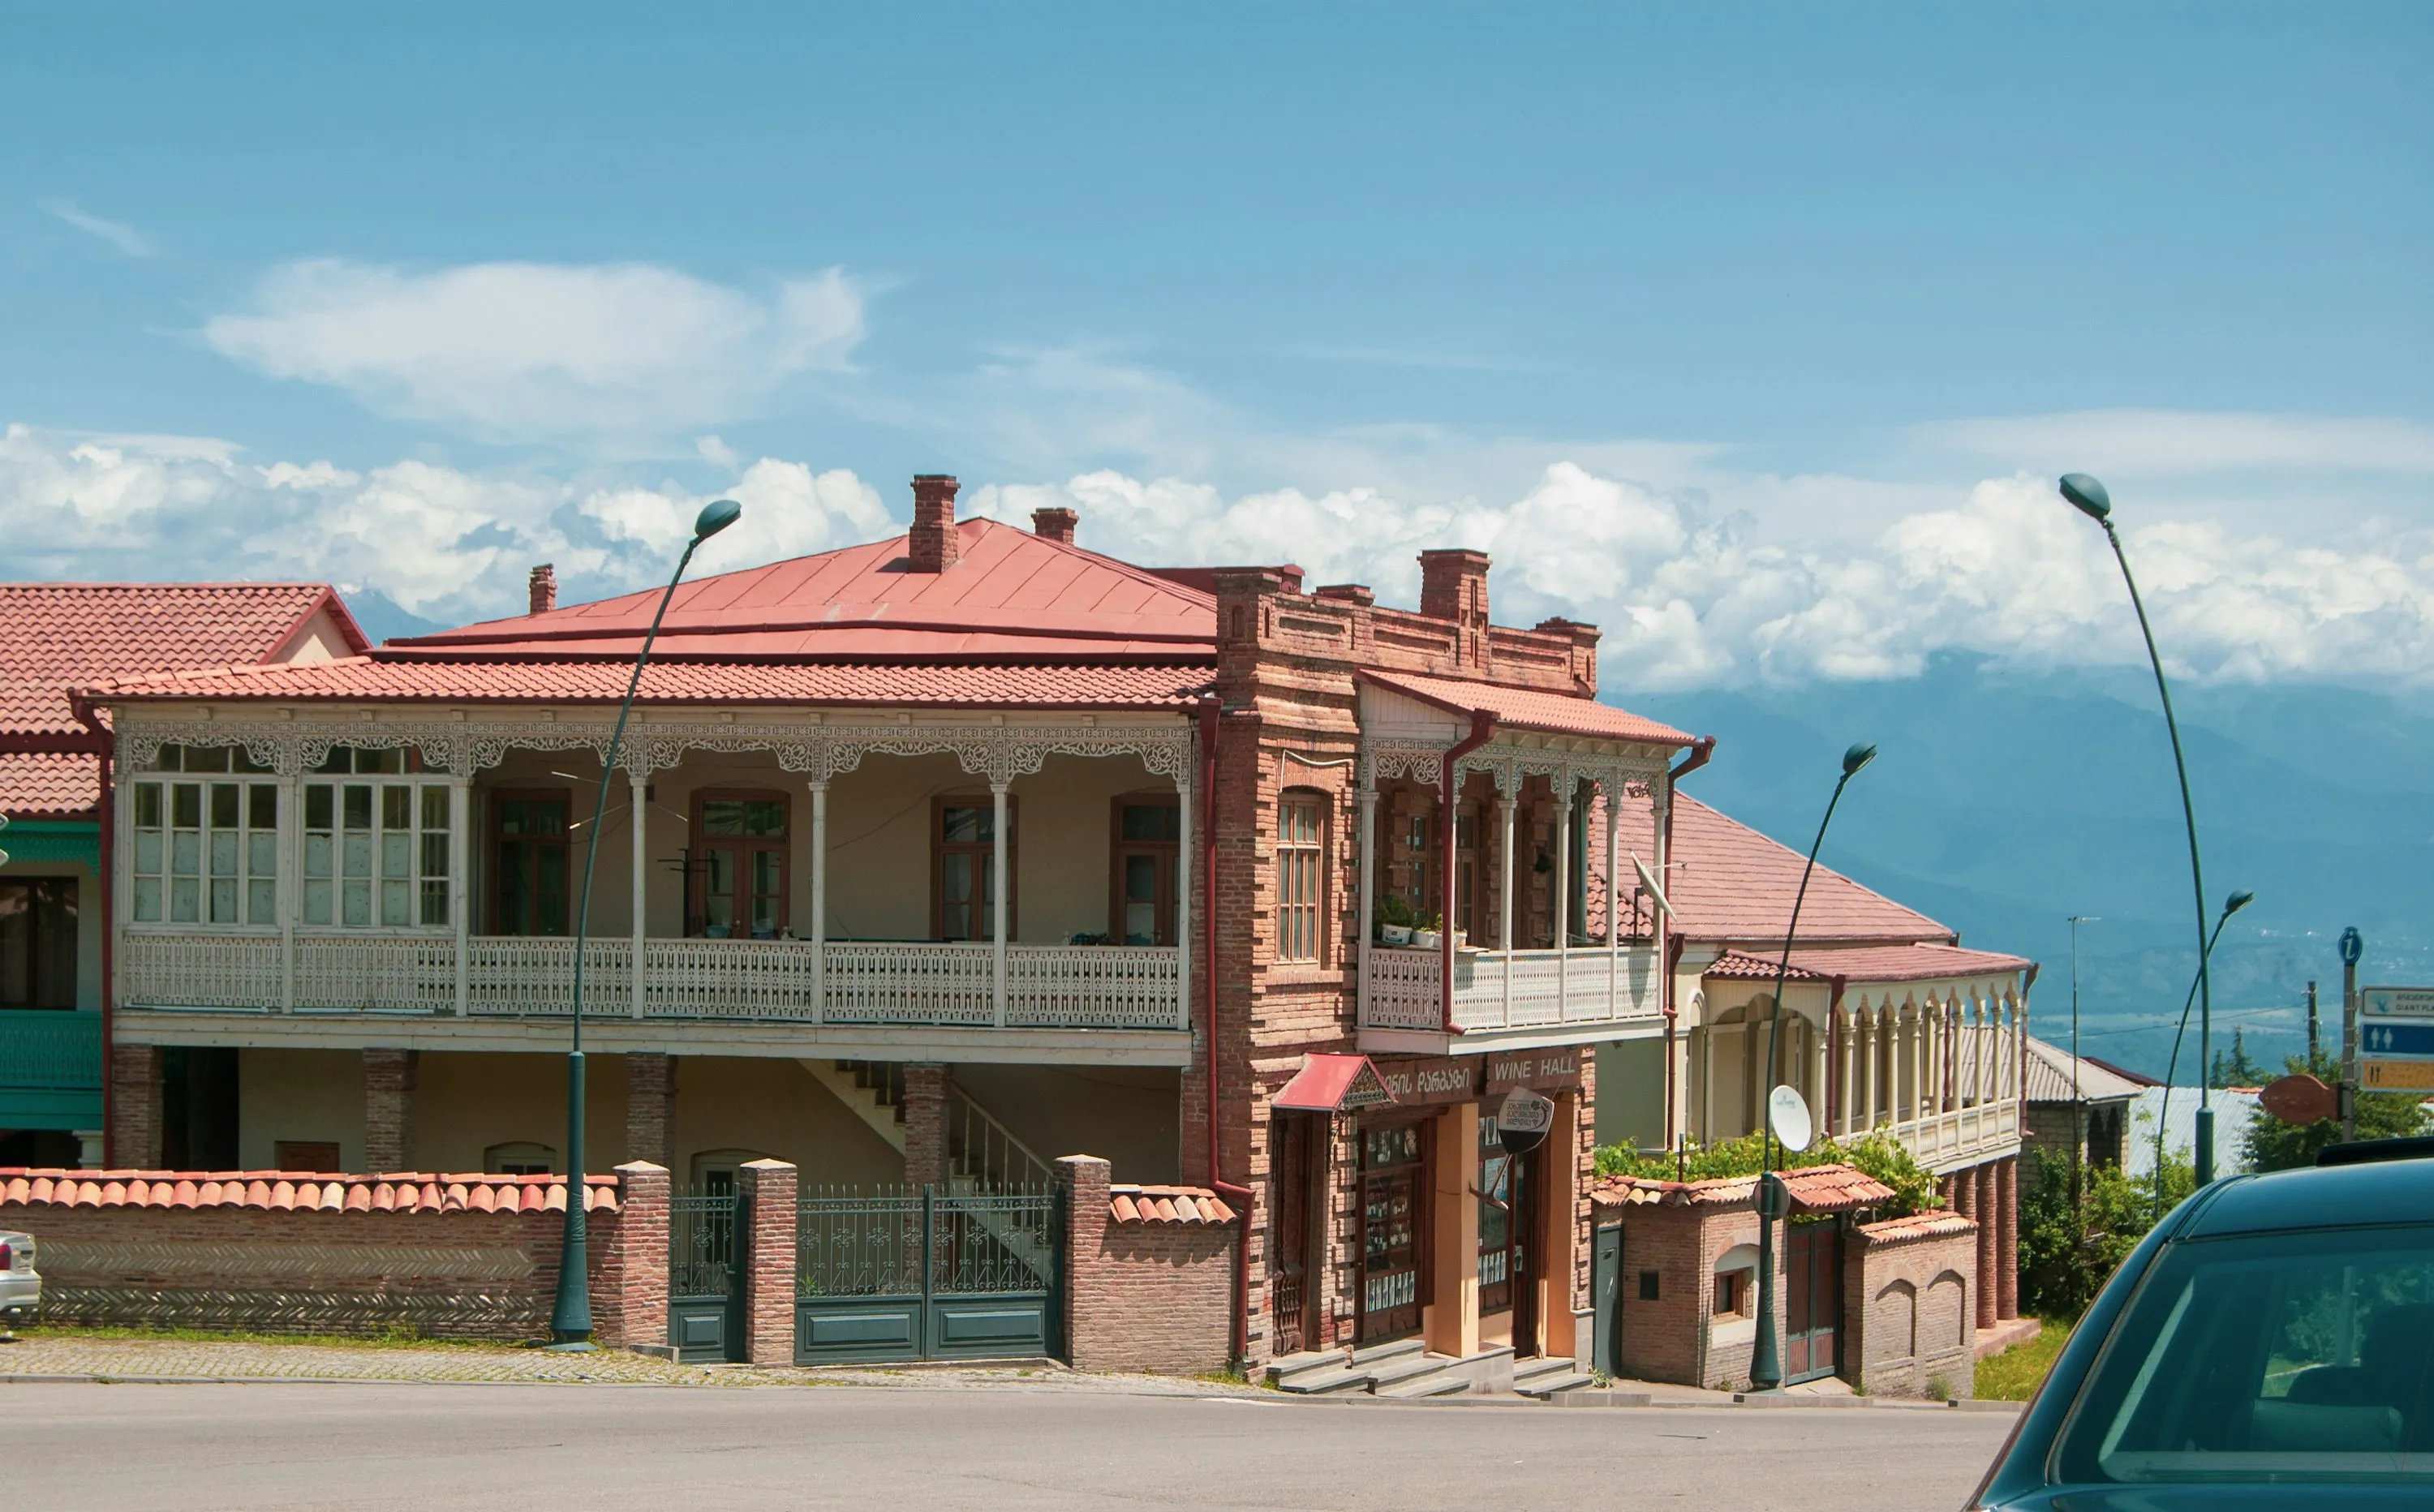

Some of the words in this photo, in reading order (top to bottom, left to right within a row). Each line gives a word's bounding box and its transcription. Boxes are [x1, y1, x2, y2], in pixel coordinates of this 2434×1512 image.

[1384, 1073, 1413, 1095] ინის
[1417, 1067, 1471, 1093] დარბაზი
[1494, 1060, 1533, 1081] WINE
[1540, 1057, 1576, 1076] HALL
